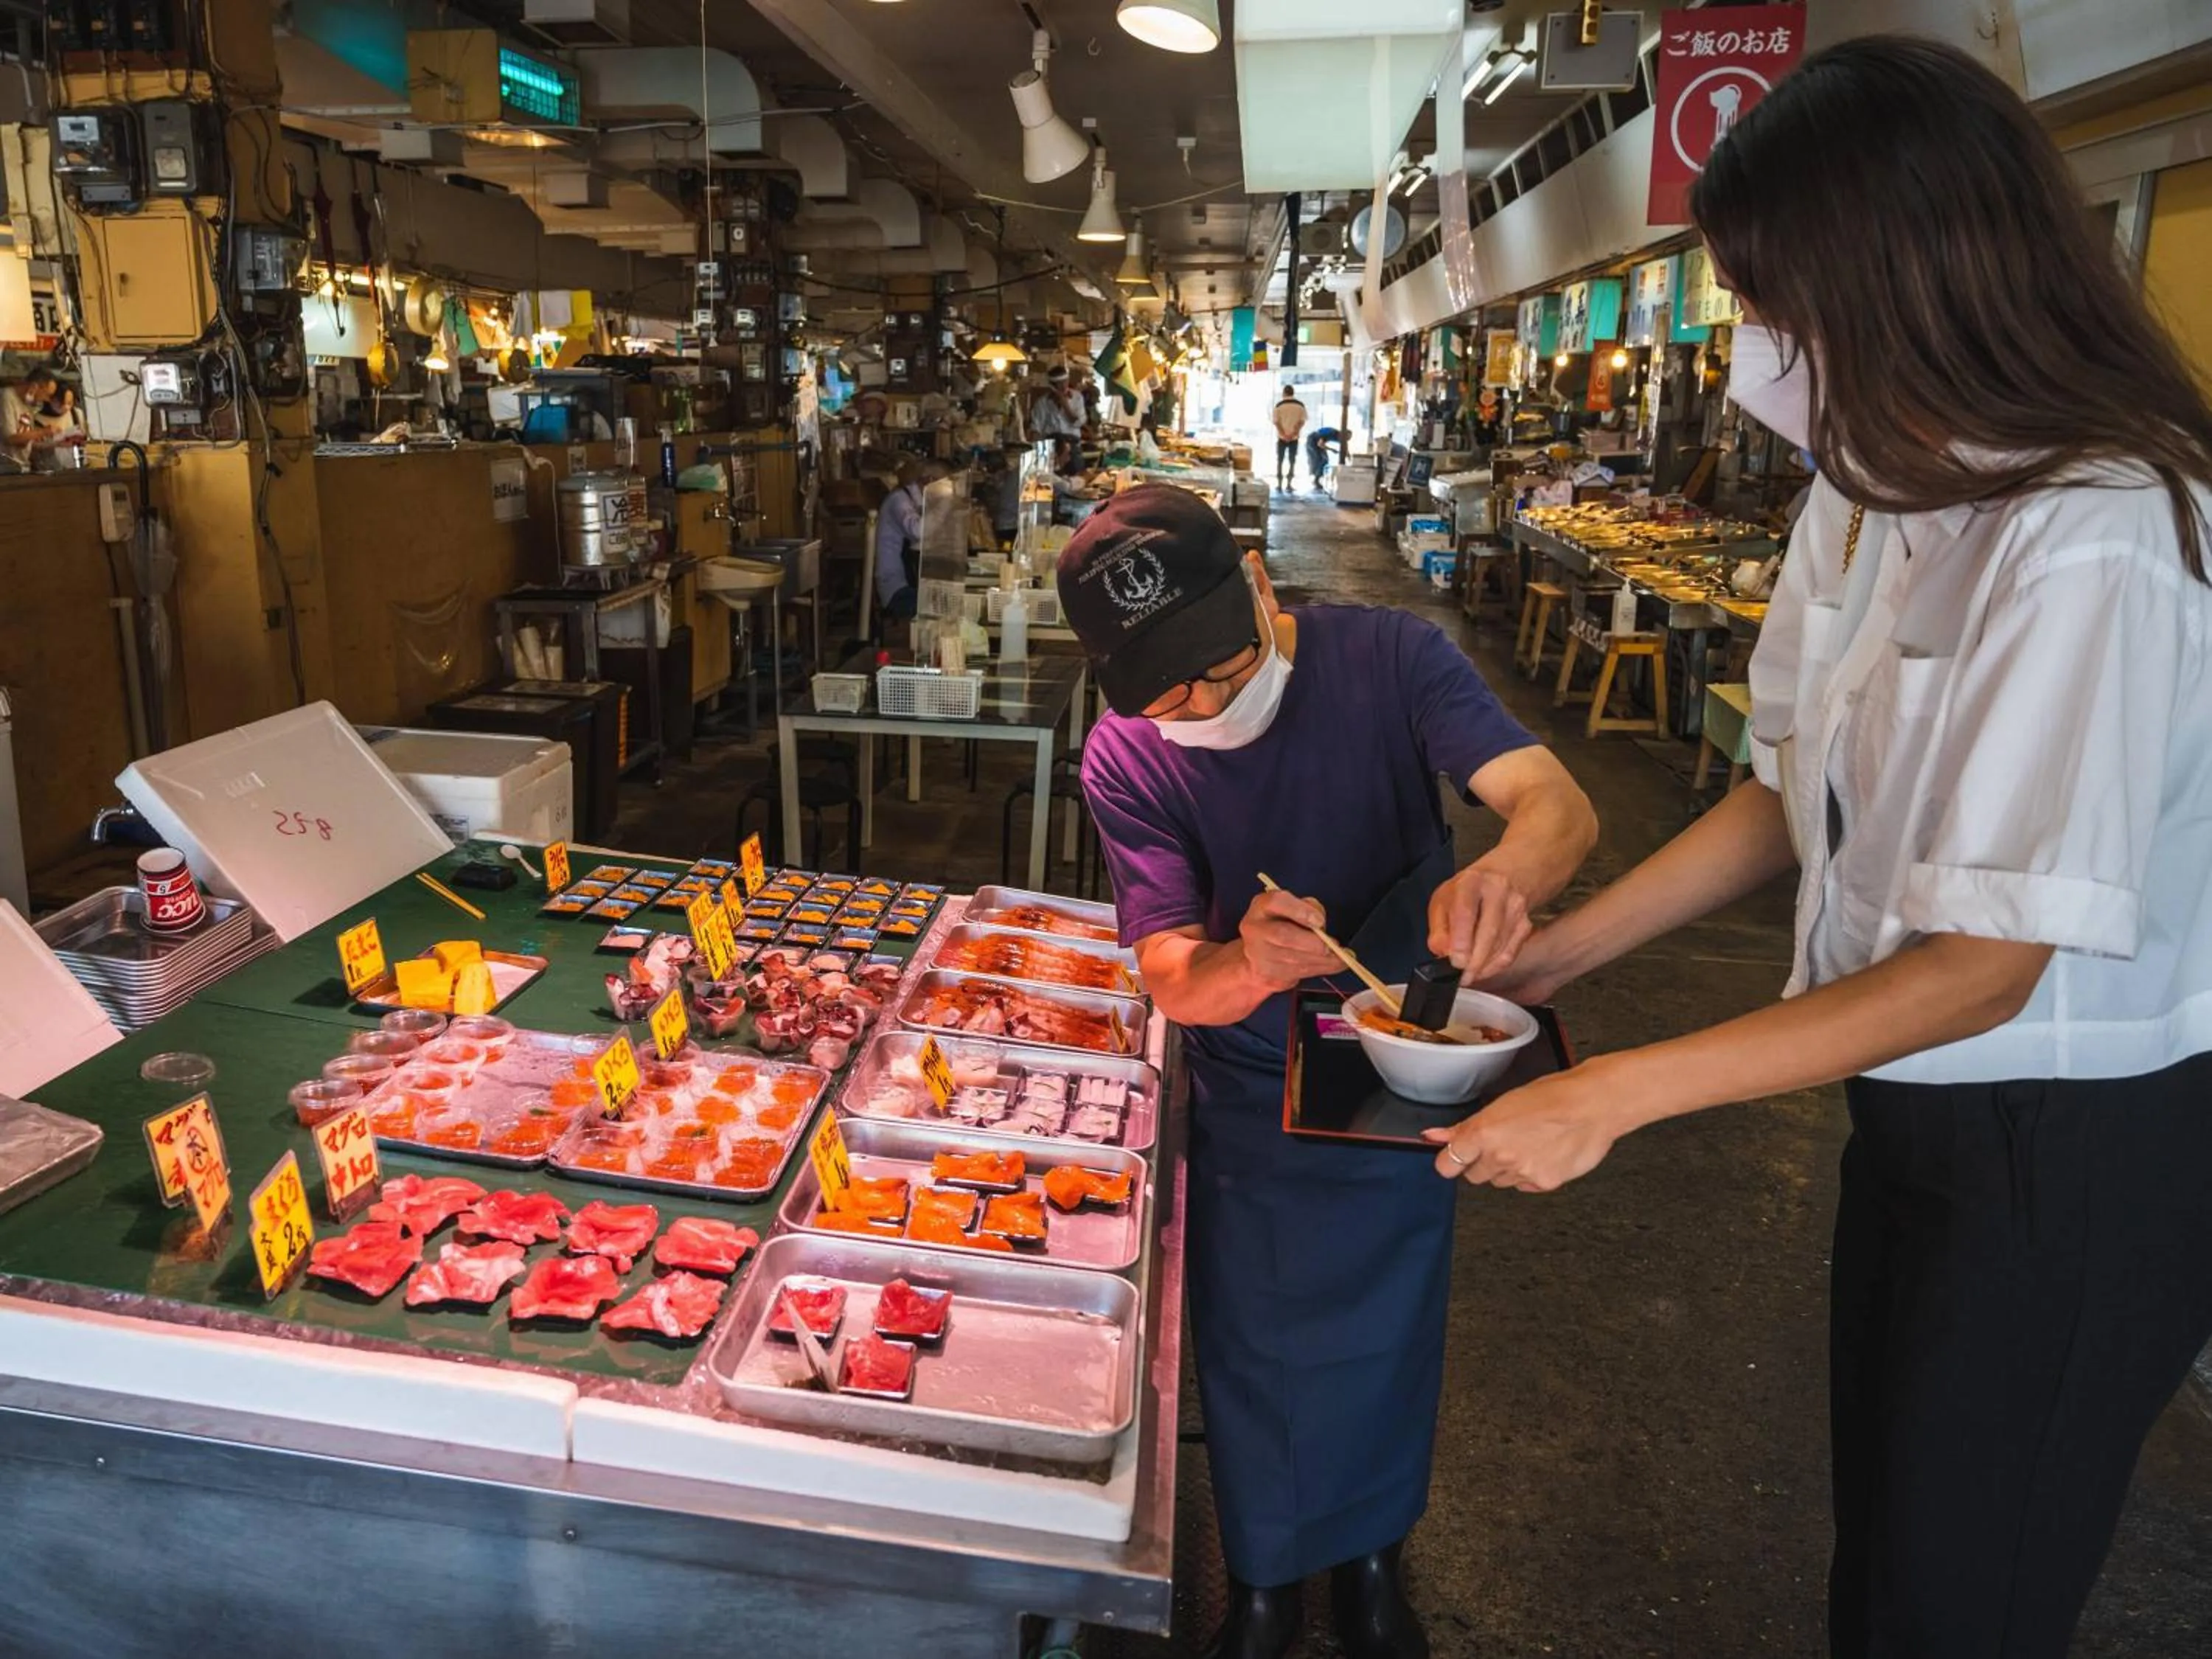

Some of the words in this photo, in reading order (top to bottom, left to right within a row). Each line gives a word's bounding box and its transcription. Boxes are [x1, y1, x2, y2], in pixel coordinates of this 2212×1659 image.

[1667, 27, 1792, 57] ご飯のお店
[324, 1111, 367, 1152] マグロ
